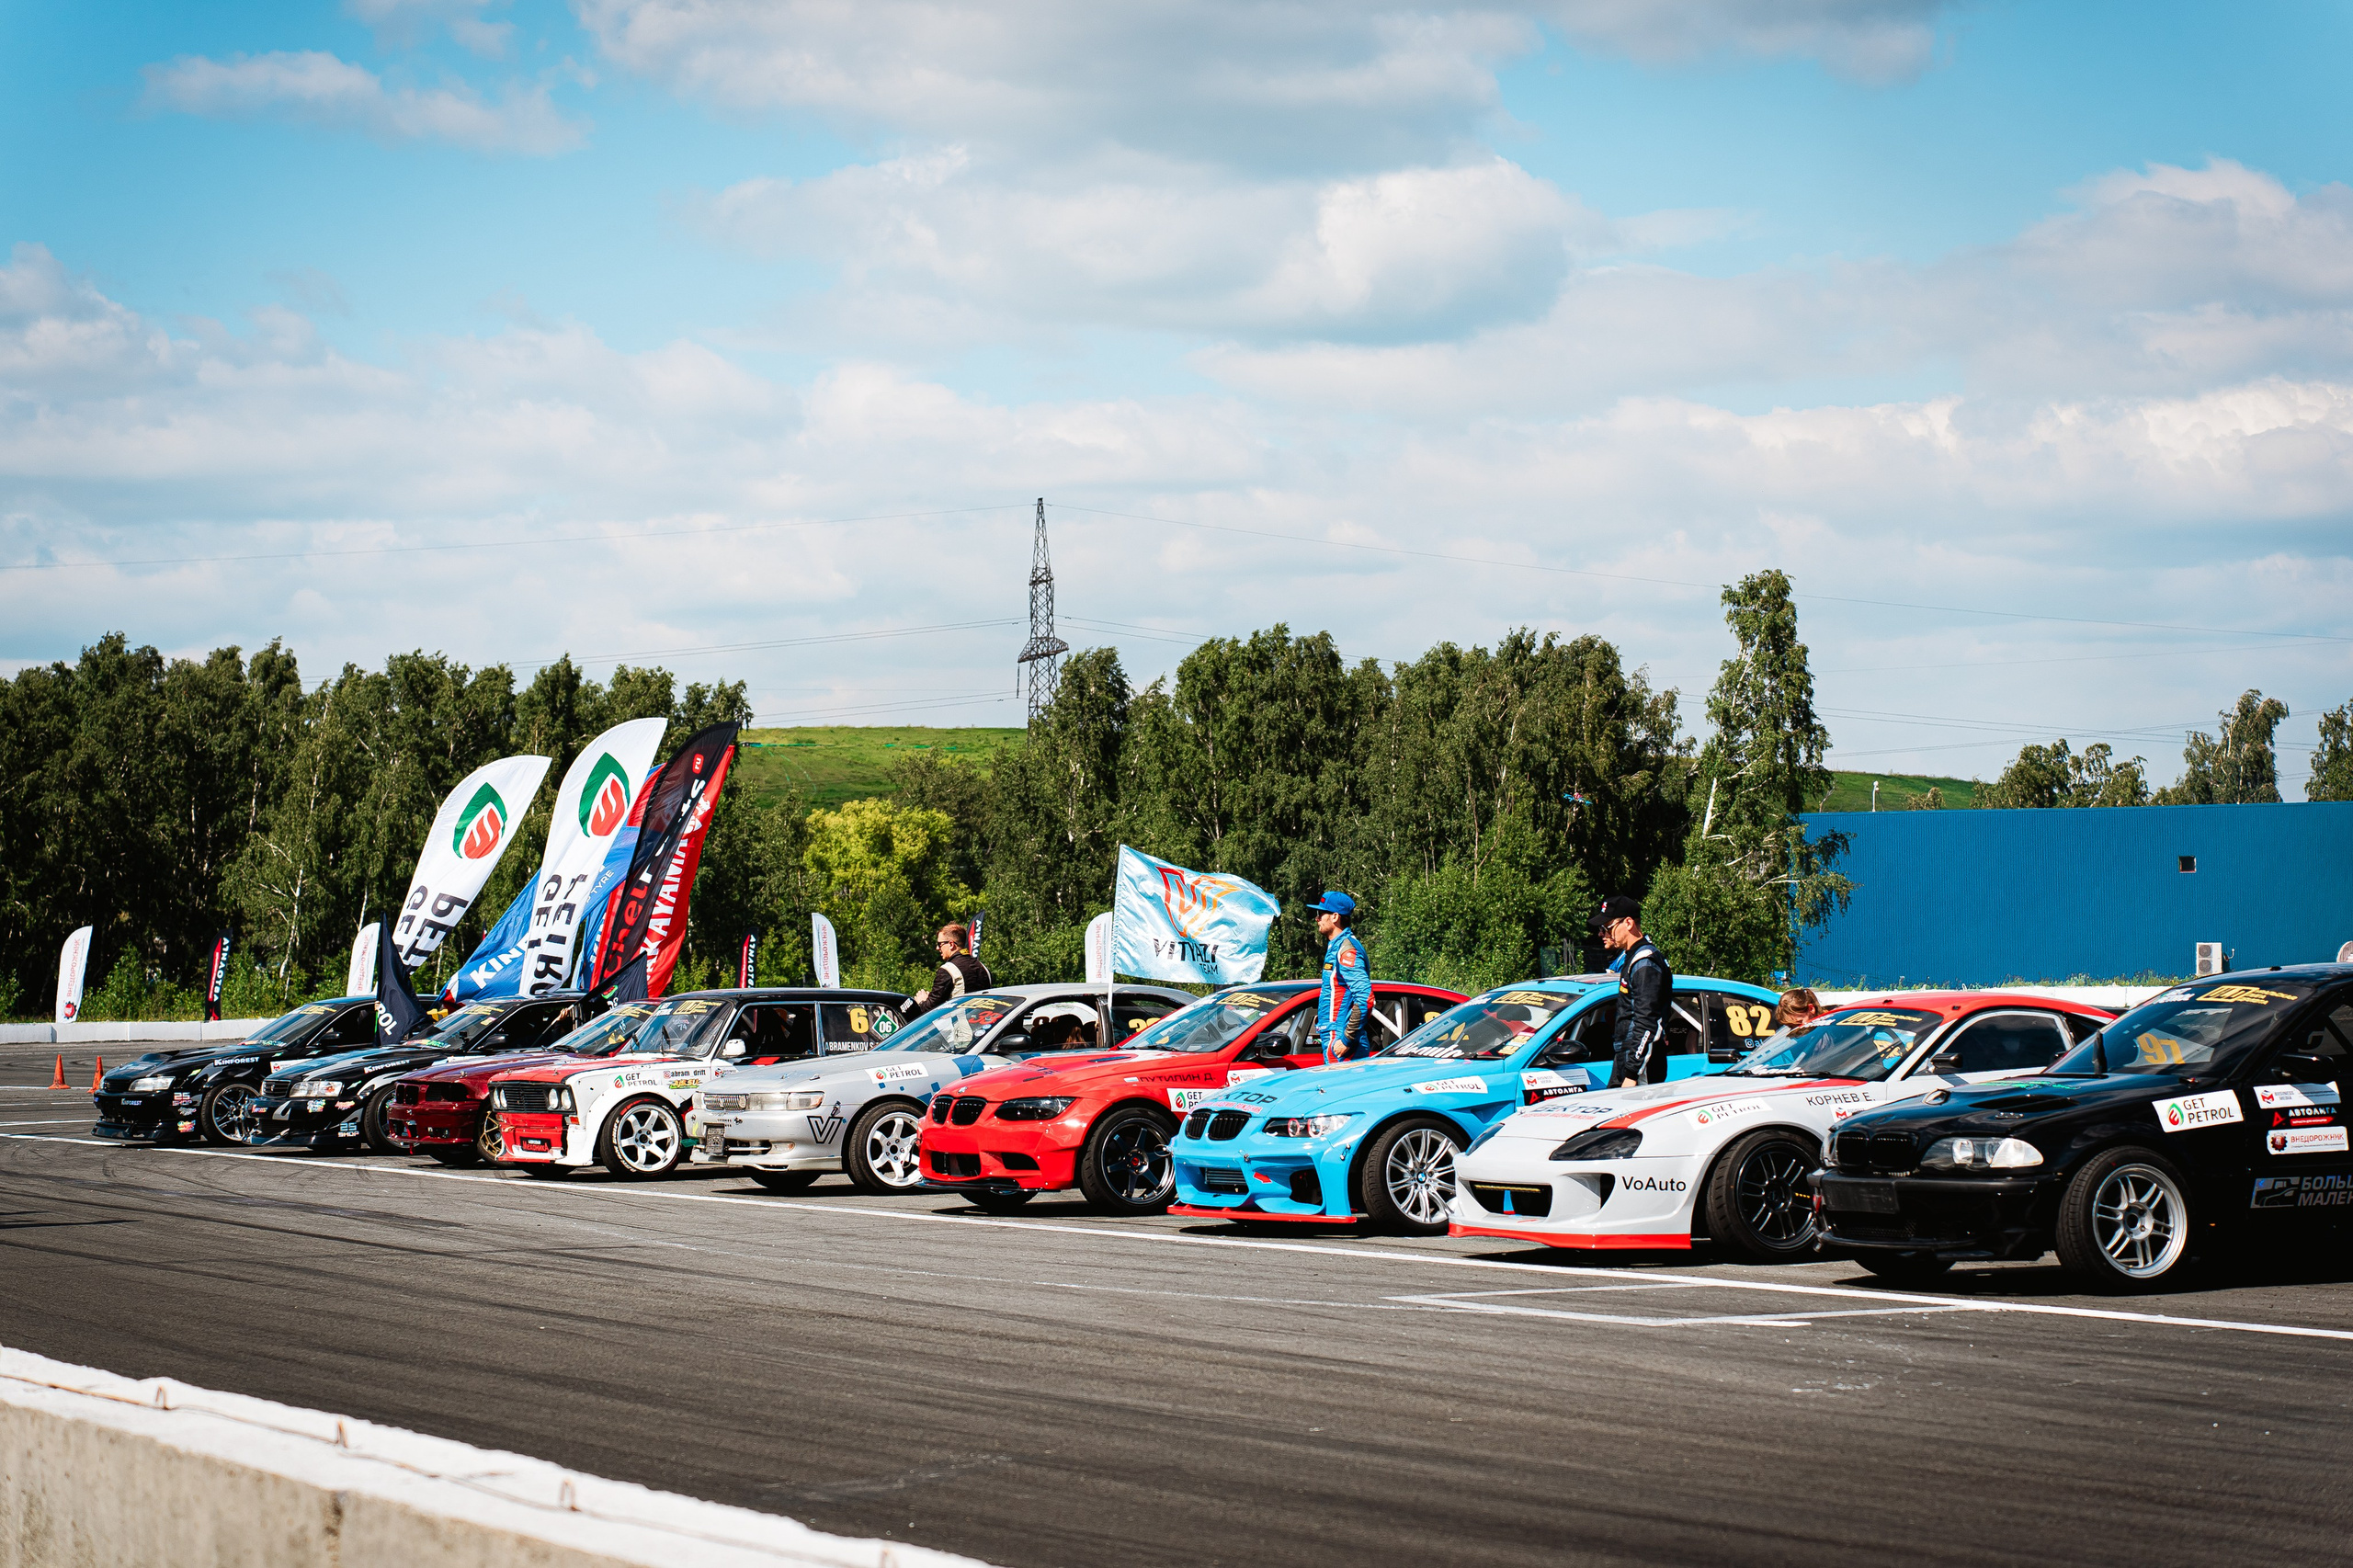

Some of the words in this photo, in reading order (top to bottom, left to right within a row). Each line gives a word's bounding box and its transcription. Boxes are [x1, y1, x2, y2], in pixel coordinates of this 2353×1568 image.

[693, 756, 702, 771] ru
[590, 869, 615, 895] TYRE
[1199, 963, 1219, 975] TEAM
[849, 1007, 869, 1034] 6
[879, 1020, 892, 1033] 06
[1725, 1005, 1776, 1037] 82
[824, 1041, 869, 1051] ABRAMENKOV
[2136, 1032, 2187, 1064] 97
[214, 1057, 260, 1066] KINFOREST
[363, 1059, 411, 1074] KINFOREST
[889, 1069, 923, 1079] PETROL
[1139, 1074, 1200, 1083] ПУТИЛИН
[627, 1079, 658, 1087] PETROL
[1187, 1091, 1203, 1100] GET
[1543, 1086, 1584, 1096] АВТОЛИГА
[1805, 1093, 1860, 1106] КОРНЕВ
[2182, 1097, 2206, 1110] GET
[1711, 1103, 1733, 1113] GET
[1716, 1104, 1764, 1119] PETROL
[2288, 1107, 2337, 1117] АВТОЛИГА
[2188, 1107, 2234, 1124] PETROL
[340, 1122, 358, 1131] 25
[2290, 1133, 2345, 1143] ВНЕДОРОЖНИК
[1621, 1176, 1687, 1192] VoAuto
